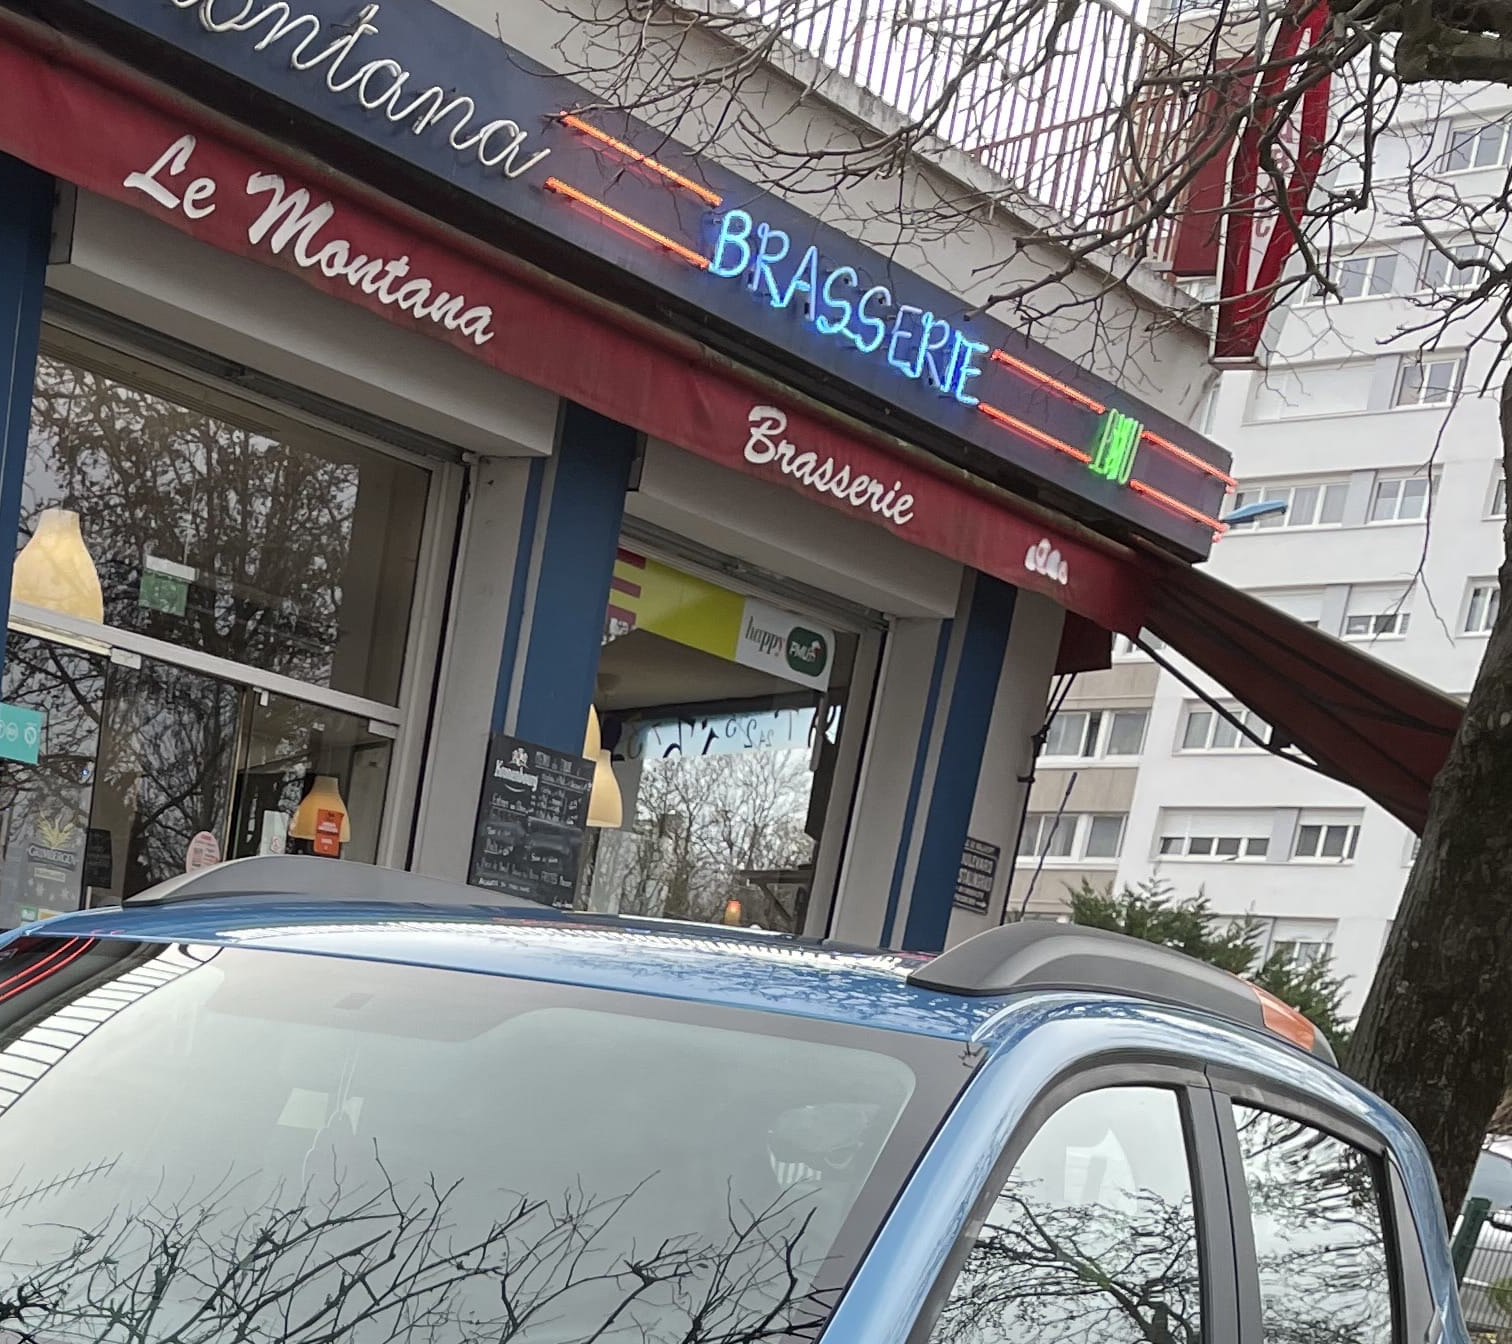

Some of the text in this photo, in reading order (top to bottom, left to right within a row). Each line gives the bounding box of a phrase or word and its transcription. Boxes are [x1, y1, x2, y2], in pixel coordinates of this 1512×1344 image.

[172, 0, 550, 180] ontana
[123, 133, 496, 347] Le Montana
[707, 208, 990, 406] BRASSERIE
[743, 404, 915, 526] Brasserie
[745, 616, 785, 657] happy
